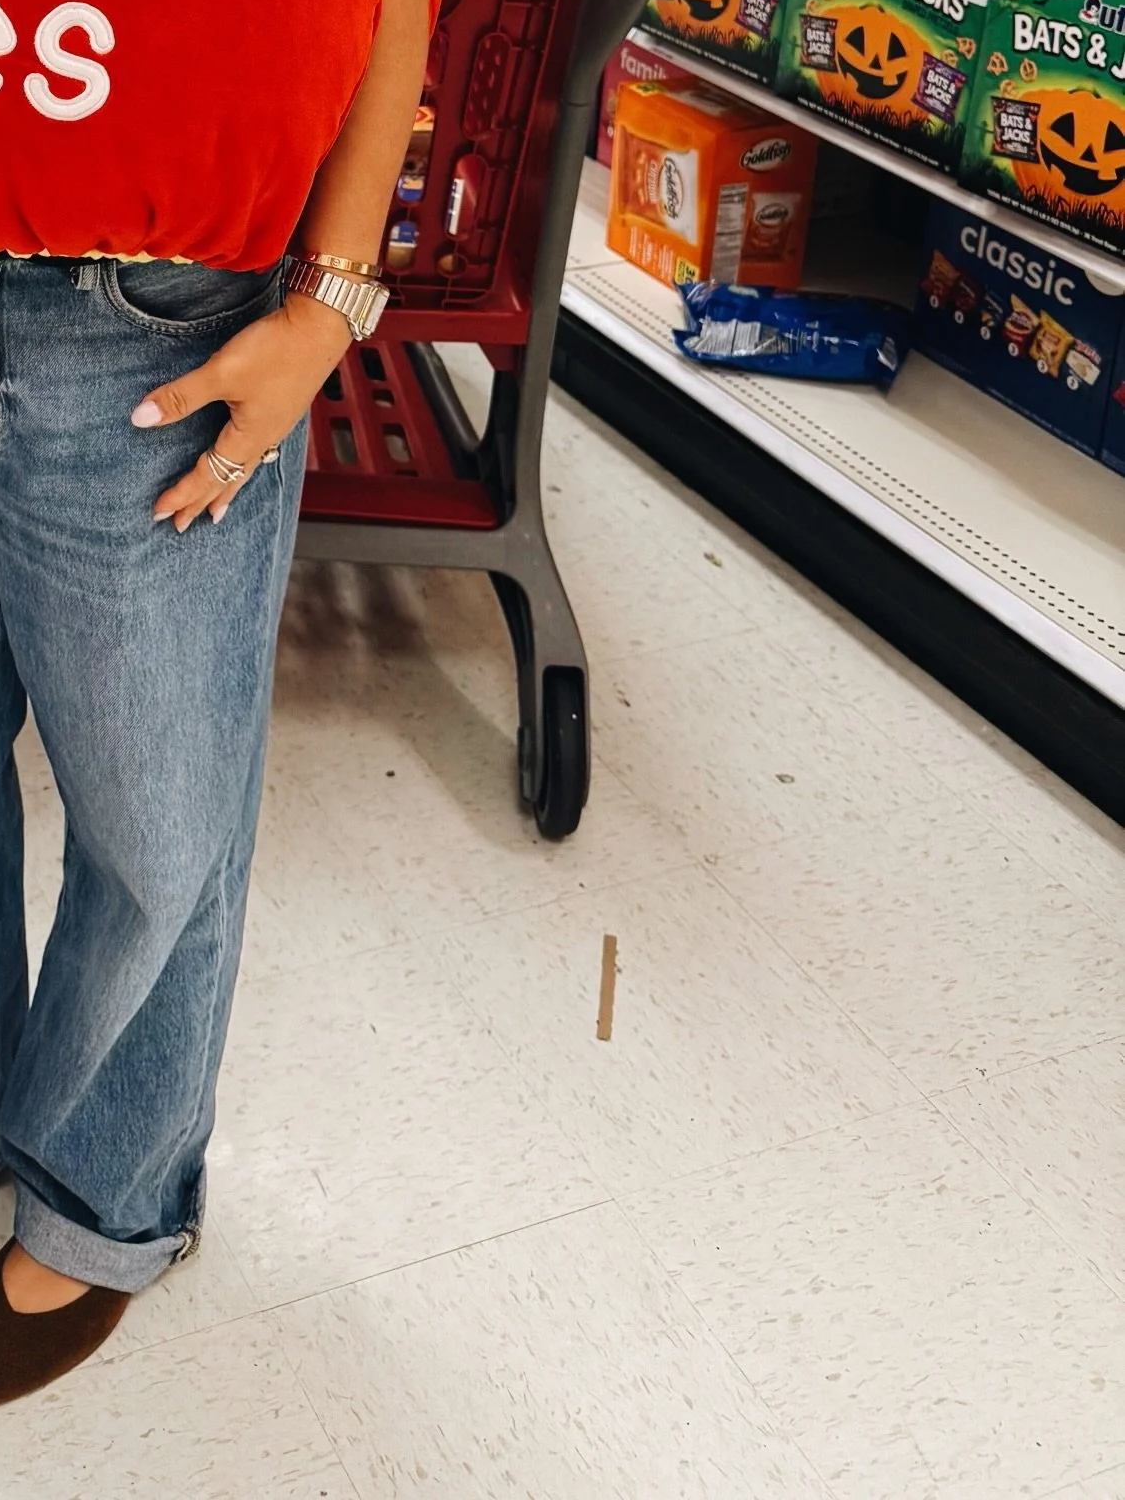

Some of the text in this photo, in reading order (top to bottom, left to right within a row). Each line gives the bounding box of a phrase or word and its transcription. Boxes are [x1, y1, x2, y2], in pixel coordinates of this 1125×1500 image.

[806, 29, 824, 42] BATS
[1013, 13, 1083, 59] BATS
[1086, 33, 1107, 68] &
[807, 42, 831, 55] JACKS
[927, 69, 948, 87] BATS
[924, 85, 952, 106] JACKS
[1000, 112, 1023, 128] BATS
[1002, 127, 1031, 144] JACKS
[740, 140, 792, 168] Goldfish
[663, 157, 679, 220] Goldfish
[960, 225, 1076, 306] classic
